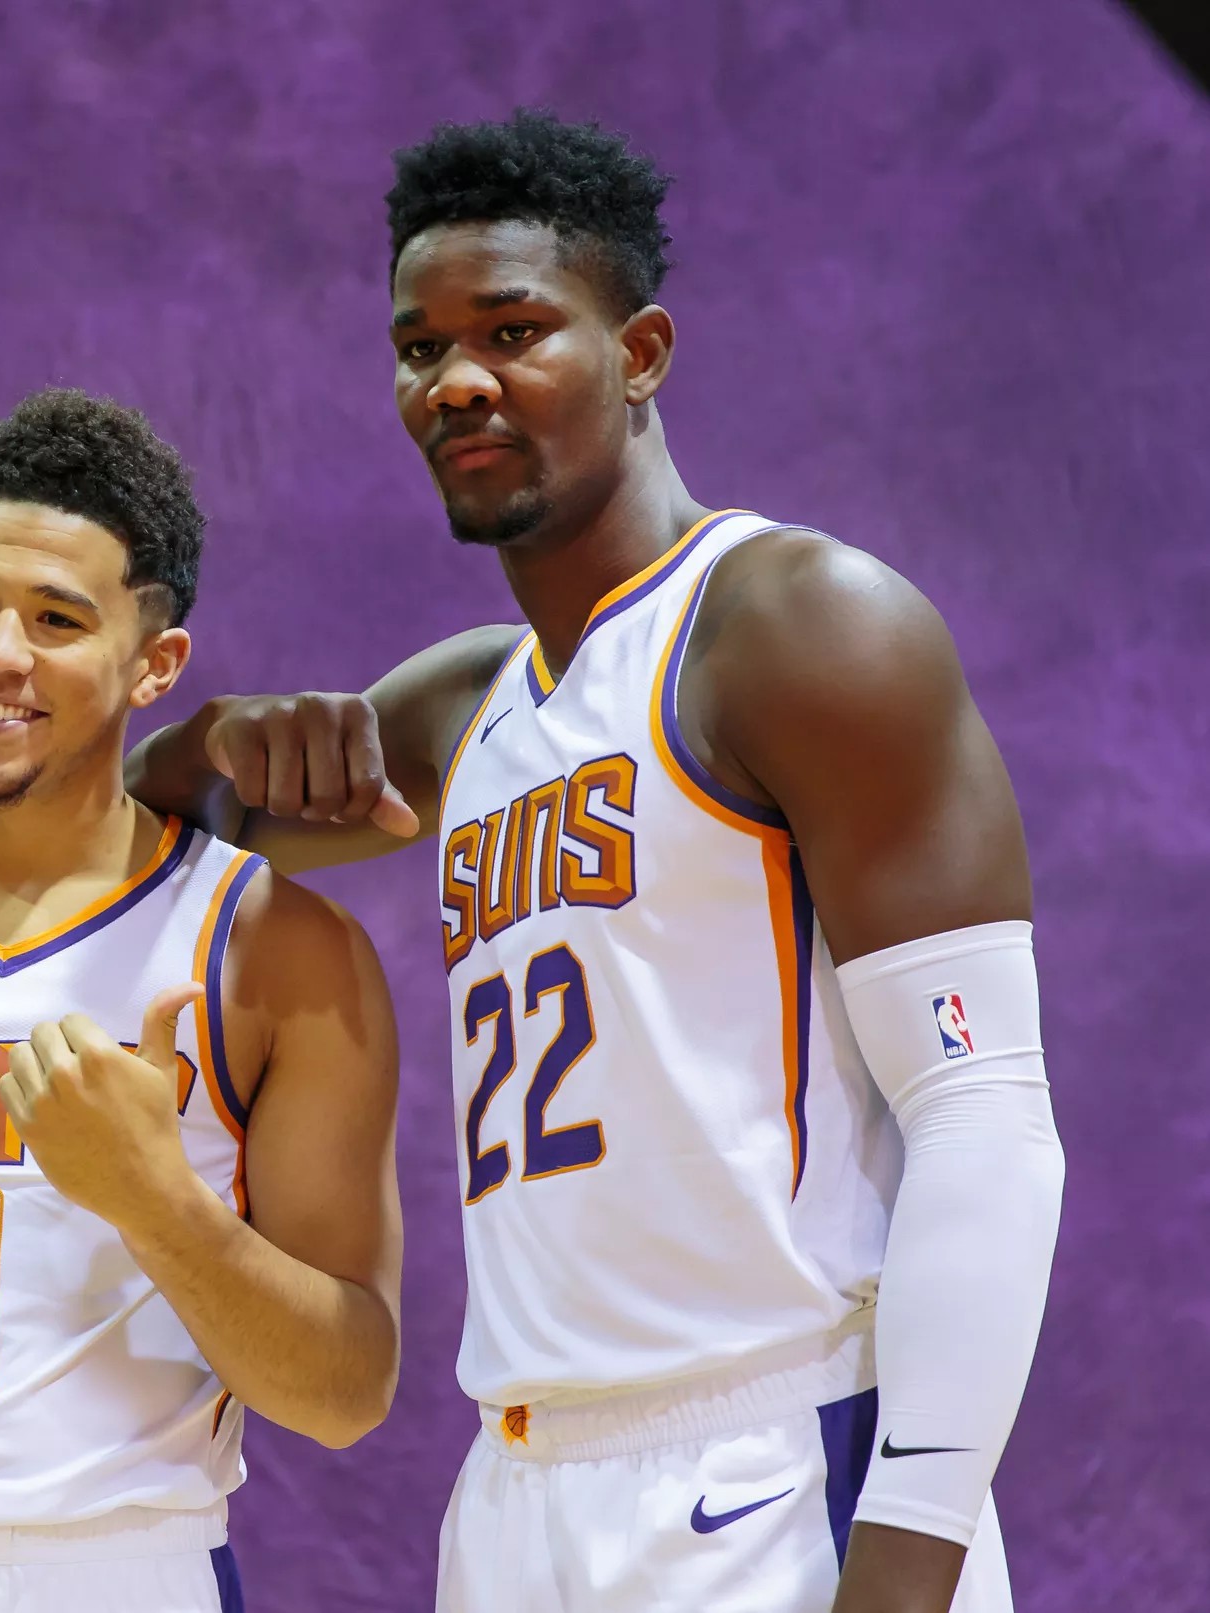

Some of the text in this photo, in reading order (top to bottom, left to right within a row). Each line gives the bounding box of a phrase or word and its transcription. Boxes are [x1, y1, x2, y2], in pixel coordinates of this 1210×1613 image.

[442, 751, 638, 976] SUNS
[463, 940, 607, 1206] 22
[946, 1044, 967, 1057] NBA
